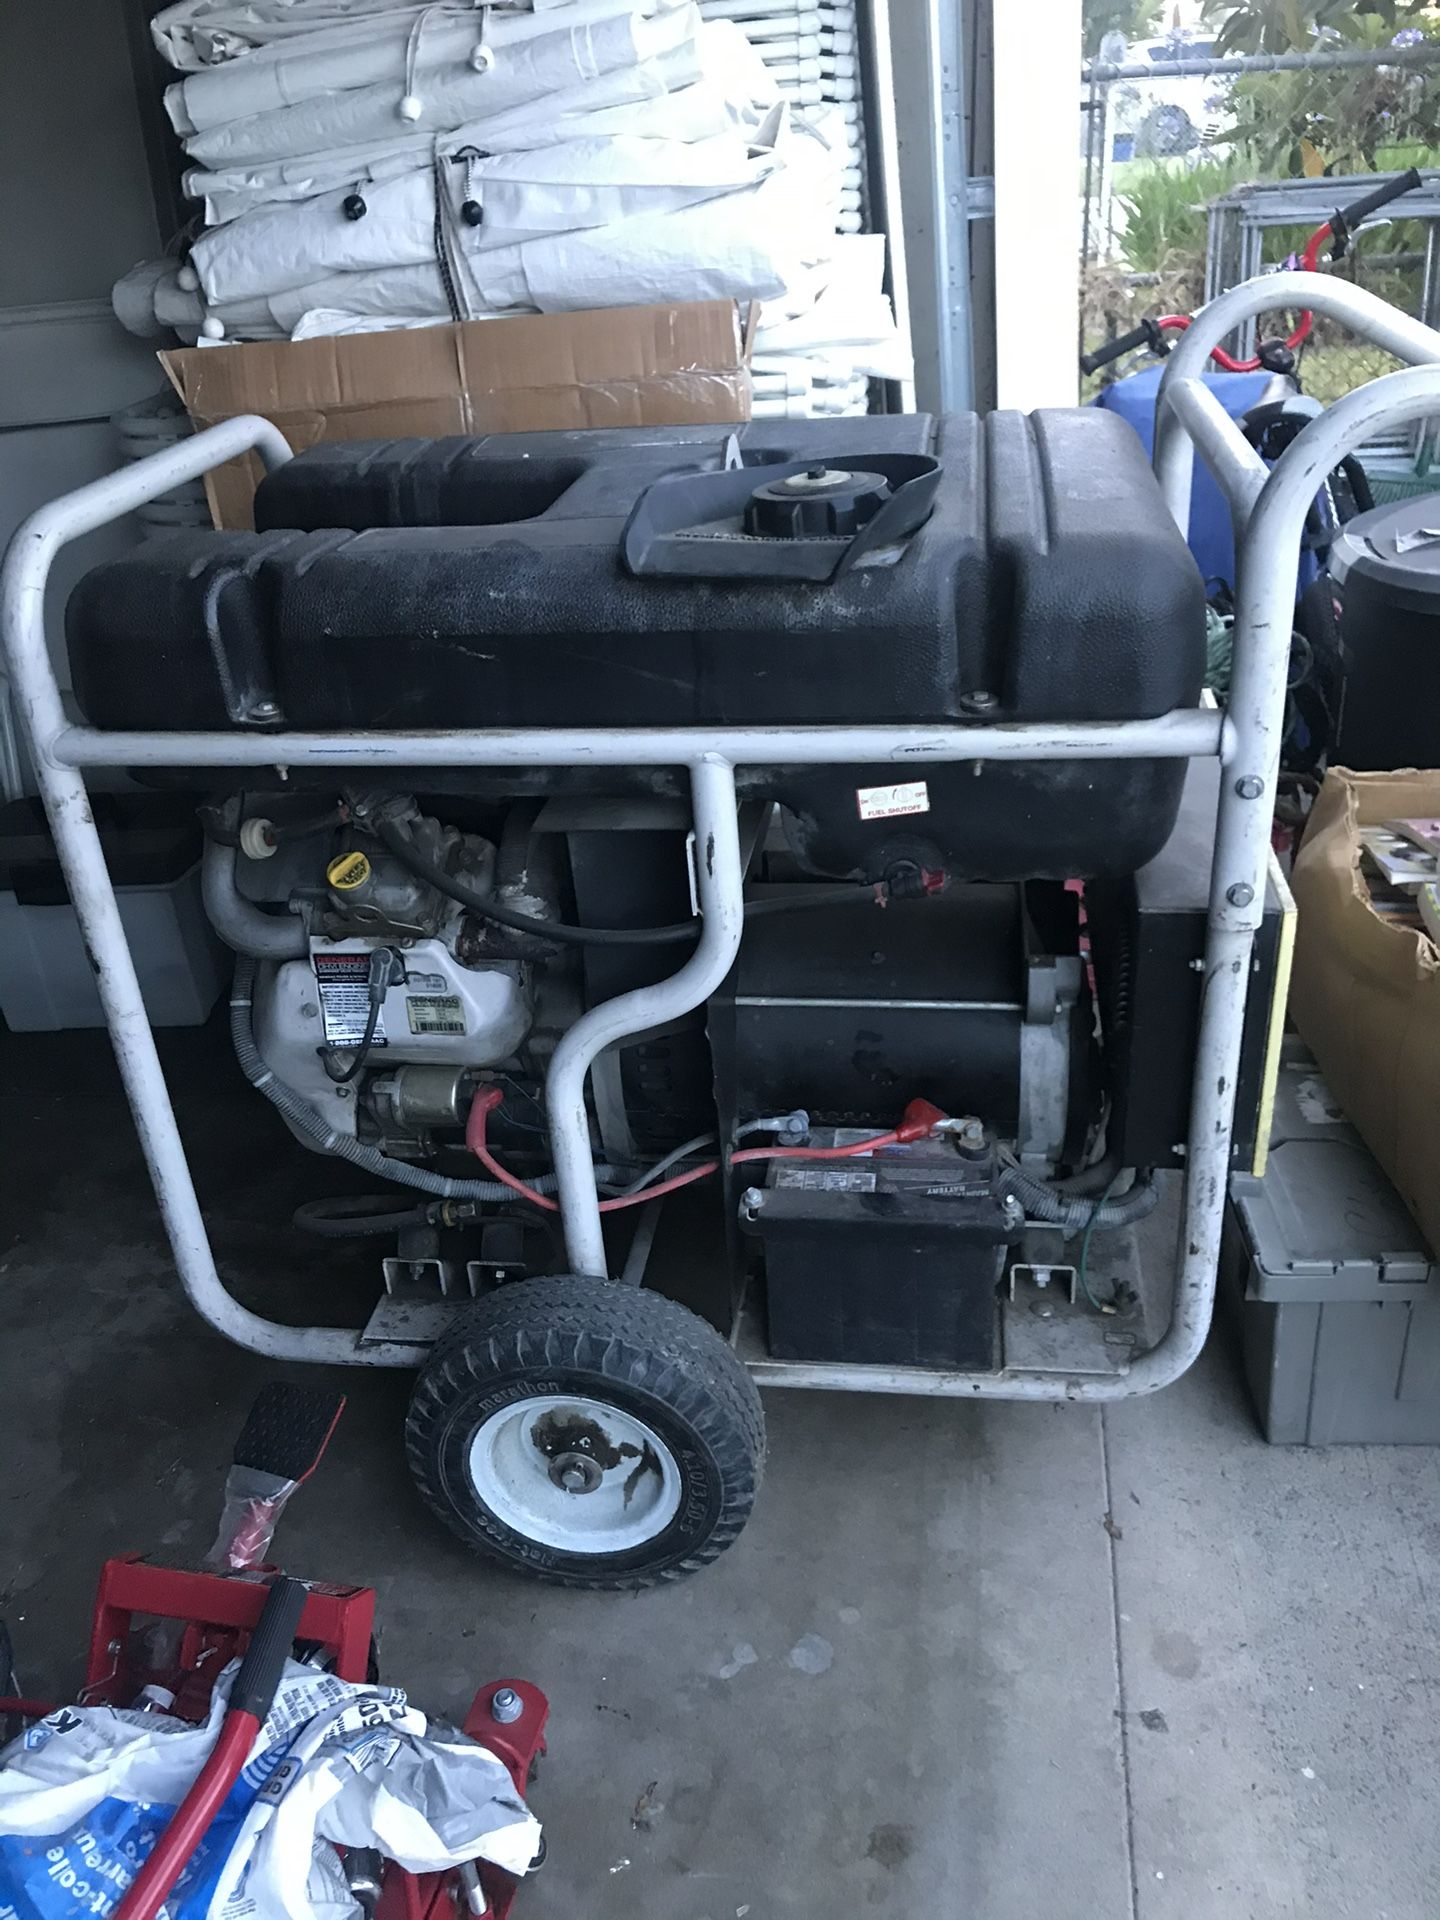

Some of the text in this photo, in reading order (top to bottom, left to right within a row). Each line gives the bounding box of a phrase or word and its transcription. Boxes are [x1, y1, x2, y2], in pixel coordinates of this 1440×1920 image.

[888, 804, 921, 814] SHUTOFF
[926, 1186, 966, 1195] BATTERY
[478, 1380, 561, 1412] marathon
